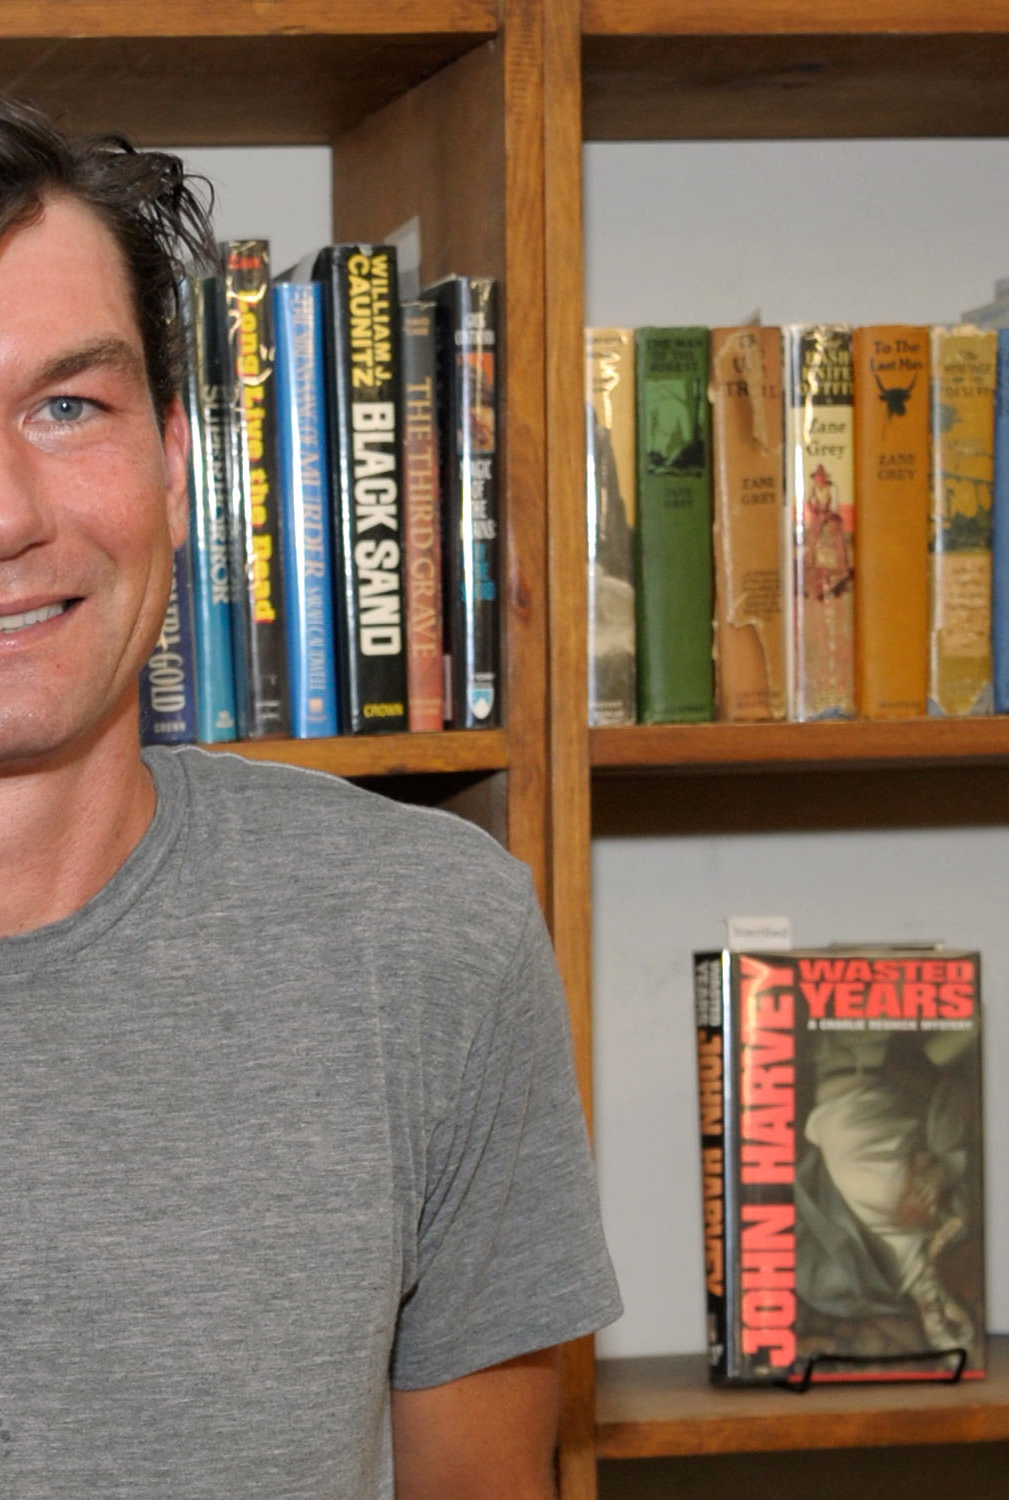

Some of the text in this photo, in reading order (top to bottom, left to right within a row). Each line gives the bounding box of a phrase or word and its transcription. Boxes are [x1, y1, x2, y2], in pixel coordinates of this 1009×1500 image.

[348, 254, 375, 388] CAUNITZ
[370, 253, 393, 387] WILLIAM J.
[873, 340, 920, 355] To The
[805, 444, 846, 460] Grey
[808, 418, 847, 435] Zane
[249, 467, 271, 528] the
[301, 451, 326, 578] MURDER
[405, 375, 438, 659] THE THIRD GRAVE
[352, 402, 402, 656] BLACK SAND
[252, 534, 277, 624] Dead
[148, 652, 187, 713] GOLD
[363, 703, 404, 718] CROWN
[797, 959, 974, 983] WASTED
[799, 982, 975, 1020] YEARS
[740, 955, 796, 1368] JOHN HARVEY
